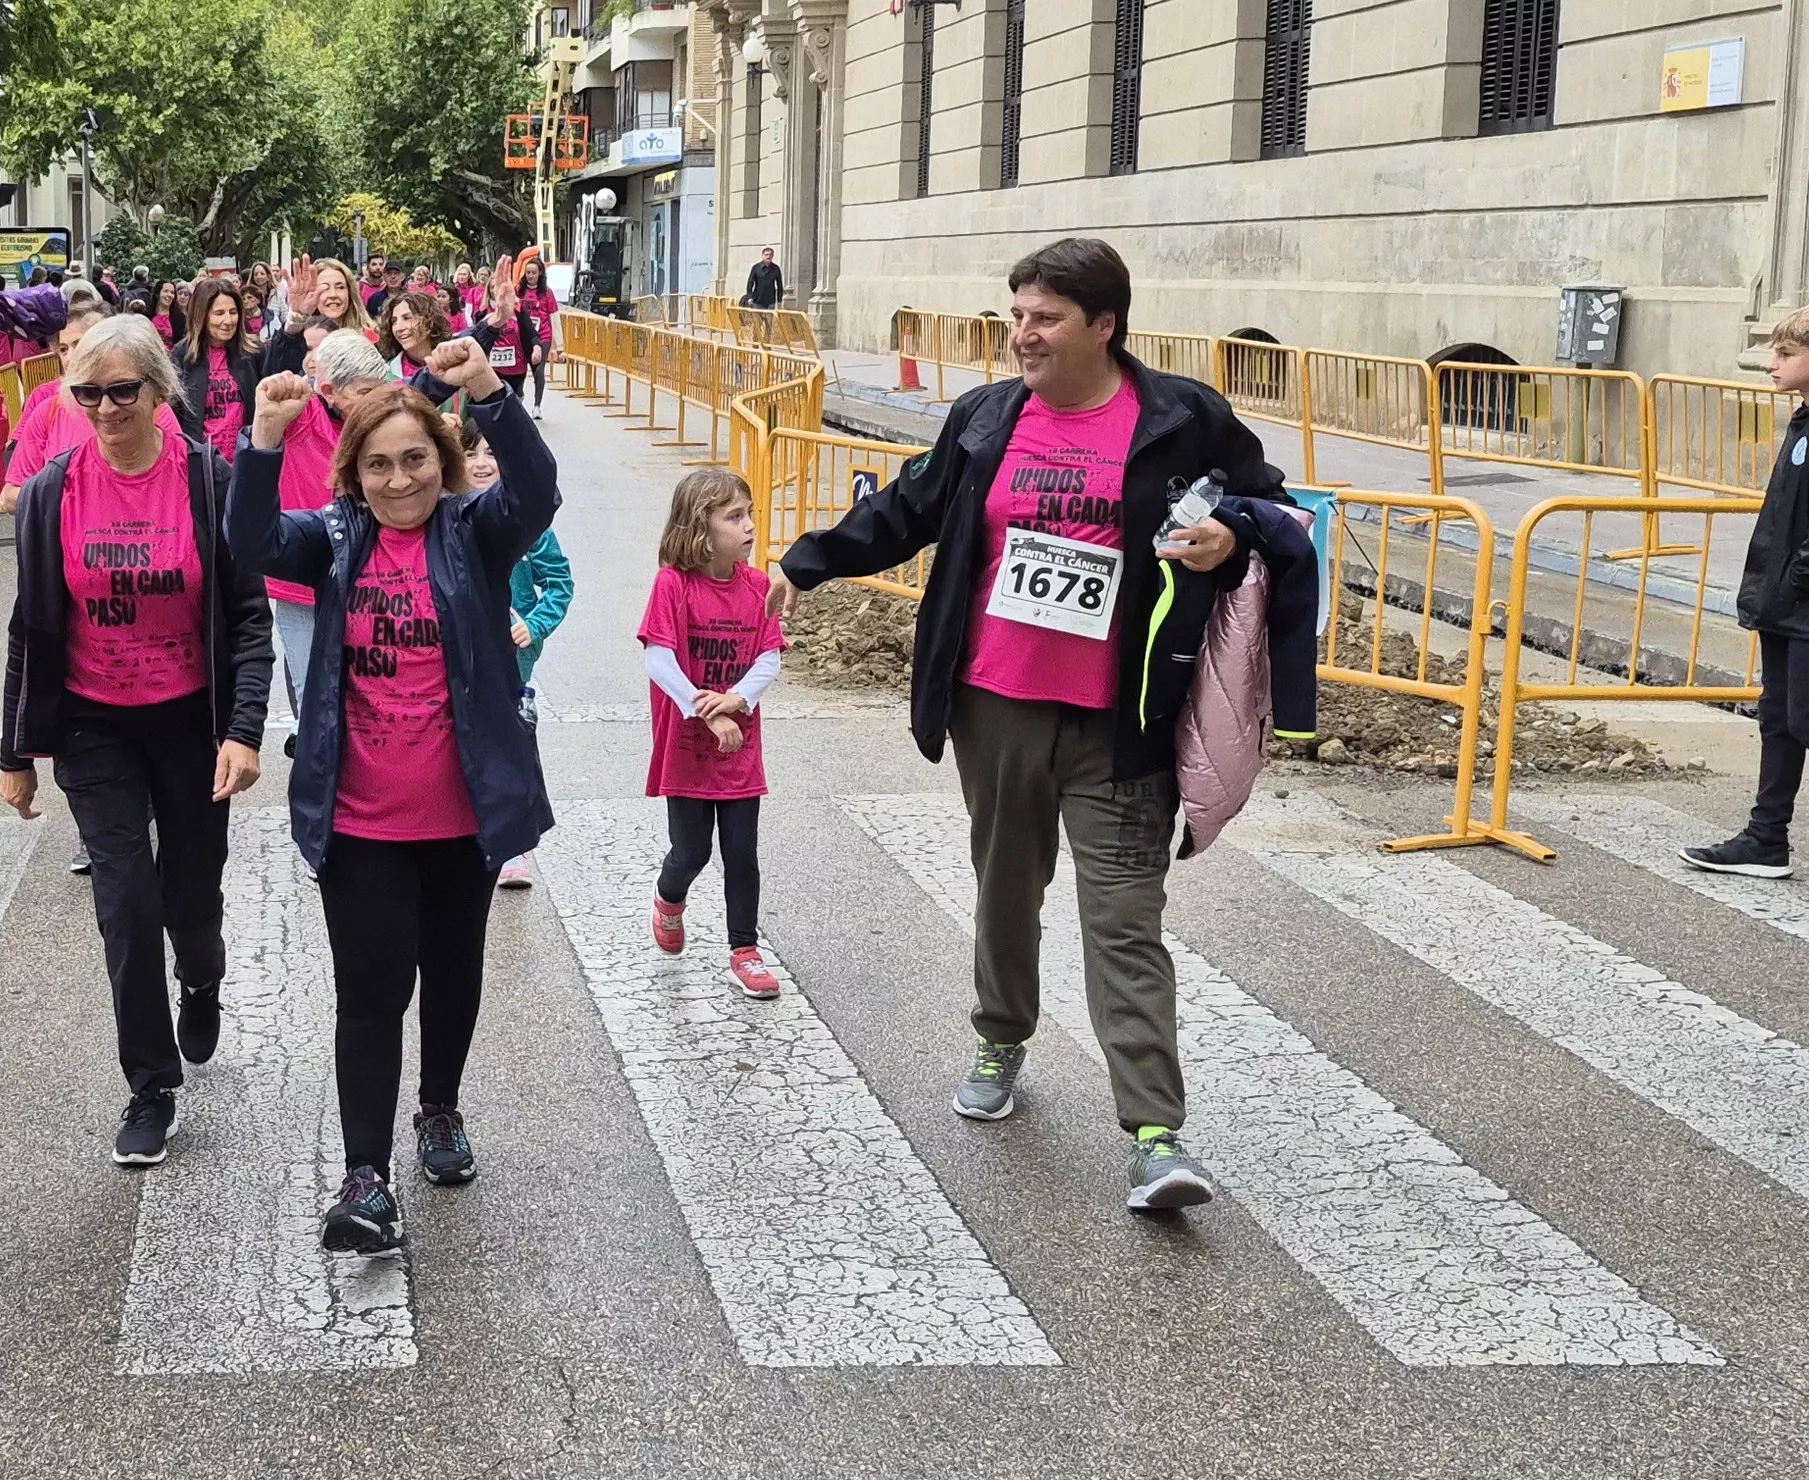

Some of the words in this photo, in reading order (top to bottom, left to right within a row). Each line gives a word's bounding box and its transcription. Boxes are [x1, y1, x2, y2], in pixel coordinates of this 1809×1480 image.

[492, 353, 513, 361] 2232
[1010, 467, 1088, 495] UNIDOS
[1036, 495, 1063, 522] EN
[83, 542, 151, 569] UNIDOS
[1014, 547, 1053, 563] CONTRA
[1054, 555, 1066, 565] EL
[1067, 558, 1109, 574] CÁNCER
[1047, 546, 1077, 558] HUESCA
[110, 569, 134, 595] EN
[137, 568, 185, 596] CADA
[1010, 562, 1106, 611] 1678
[85, 597, 136, 627] PASO
[347, 586, 413, 617] UNIDOS
[372, 616, 397, 646] EN
[399, 618, 441, 647] CAD
[703, 662, 723, 684] EN
